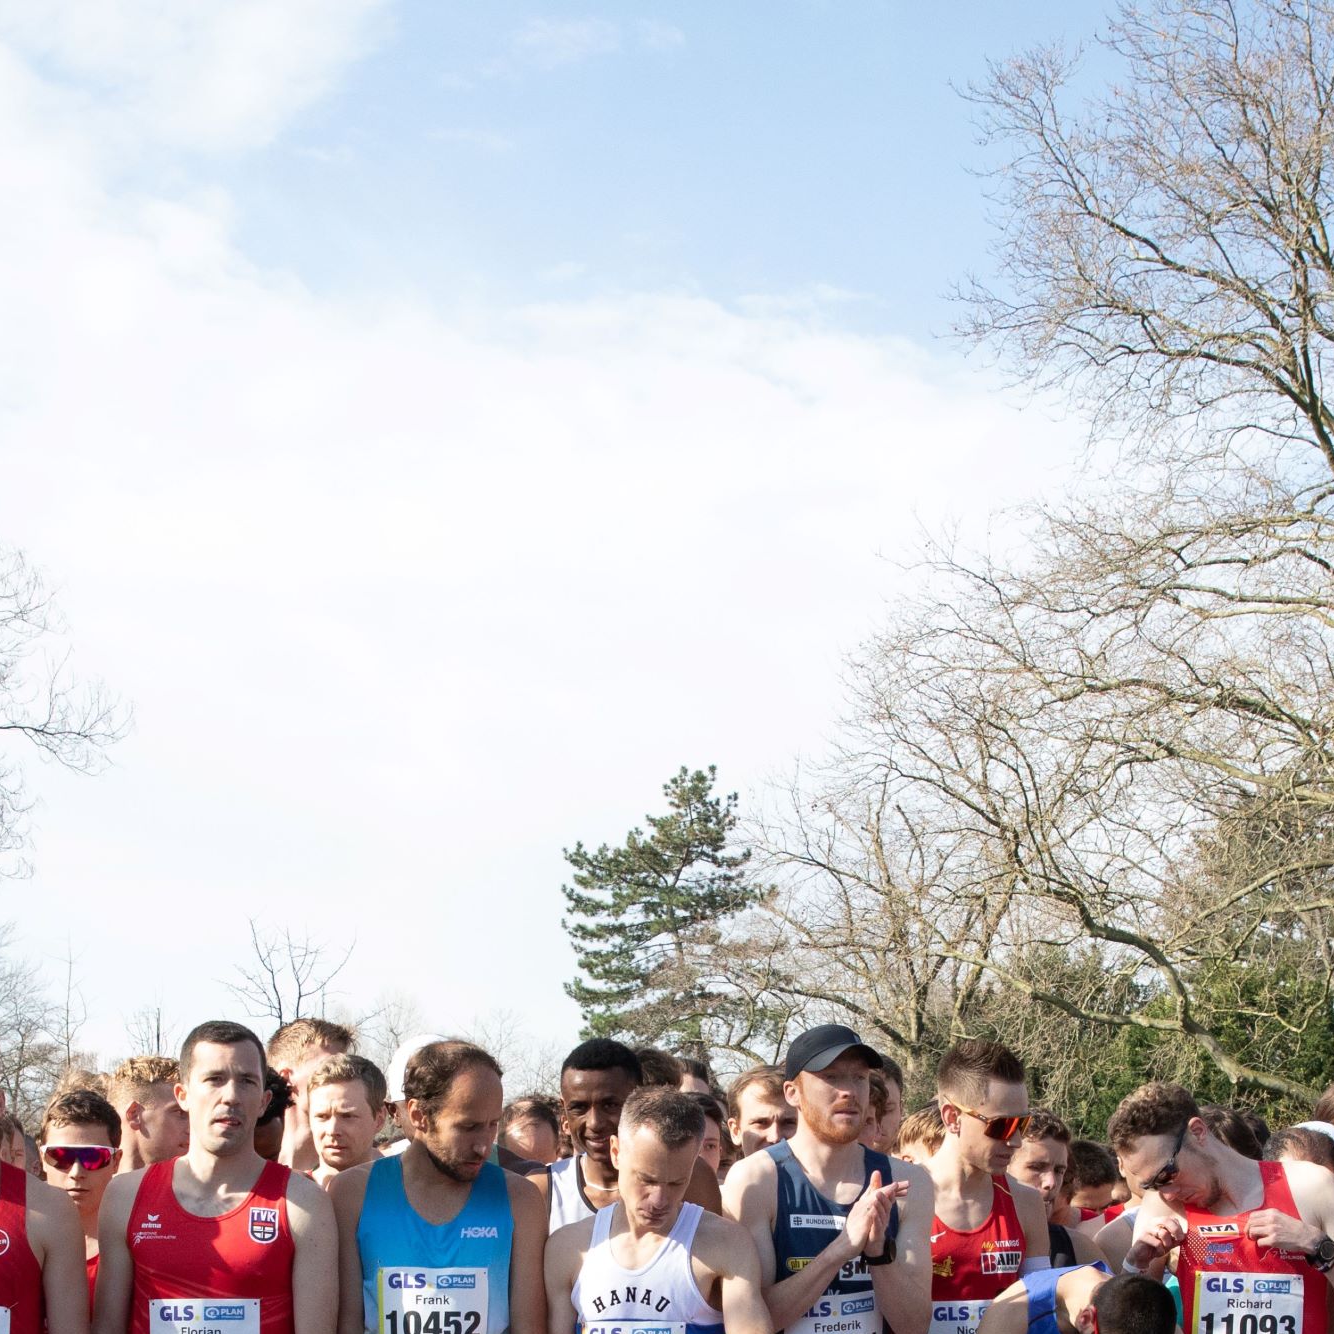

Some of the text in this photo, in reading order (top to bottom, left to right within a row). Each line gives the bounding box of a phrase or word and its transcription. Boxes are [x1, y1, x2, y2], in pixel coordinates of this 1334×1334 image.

[252, 1209, 276, 1223] TVK
[460, 1226, 499, 1239] HOKA
[1199, 1224, 1236, 1233] NTA
[452, 1276, 475, 1284] PLAN
[1269, 1282, 1289, 1290] PLAN
[415, 1294, 450, 1305] Frank
[592, 1286, 671, 1313] HANAU
[1227, 1298, 1272, 1309] Richard
[220, 1307, 244, 1316] PLAN
[814, 1320, 862, 1333] Frederik
